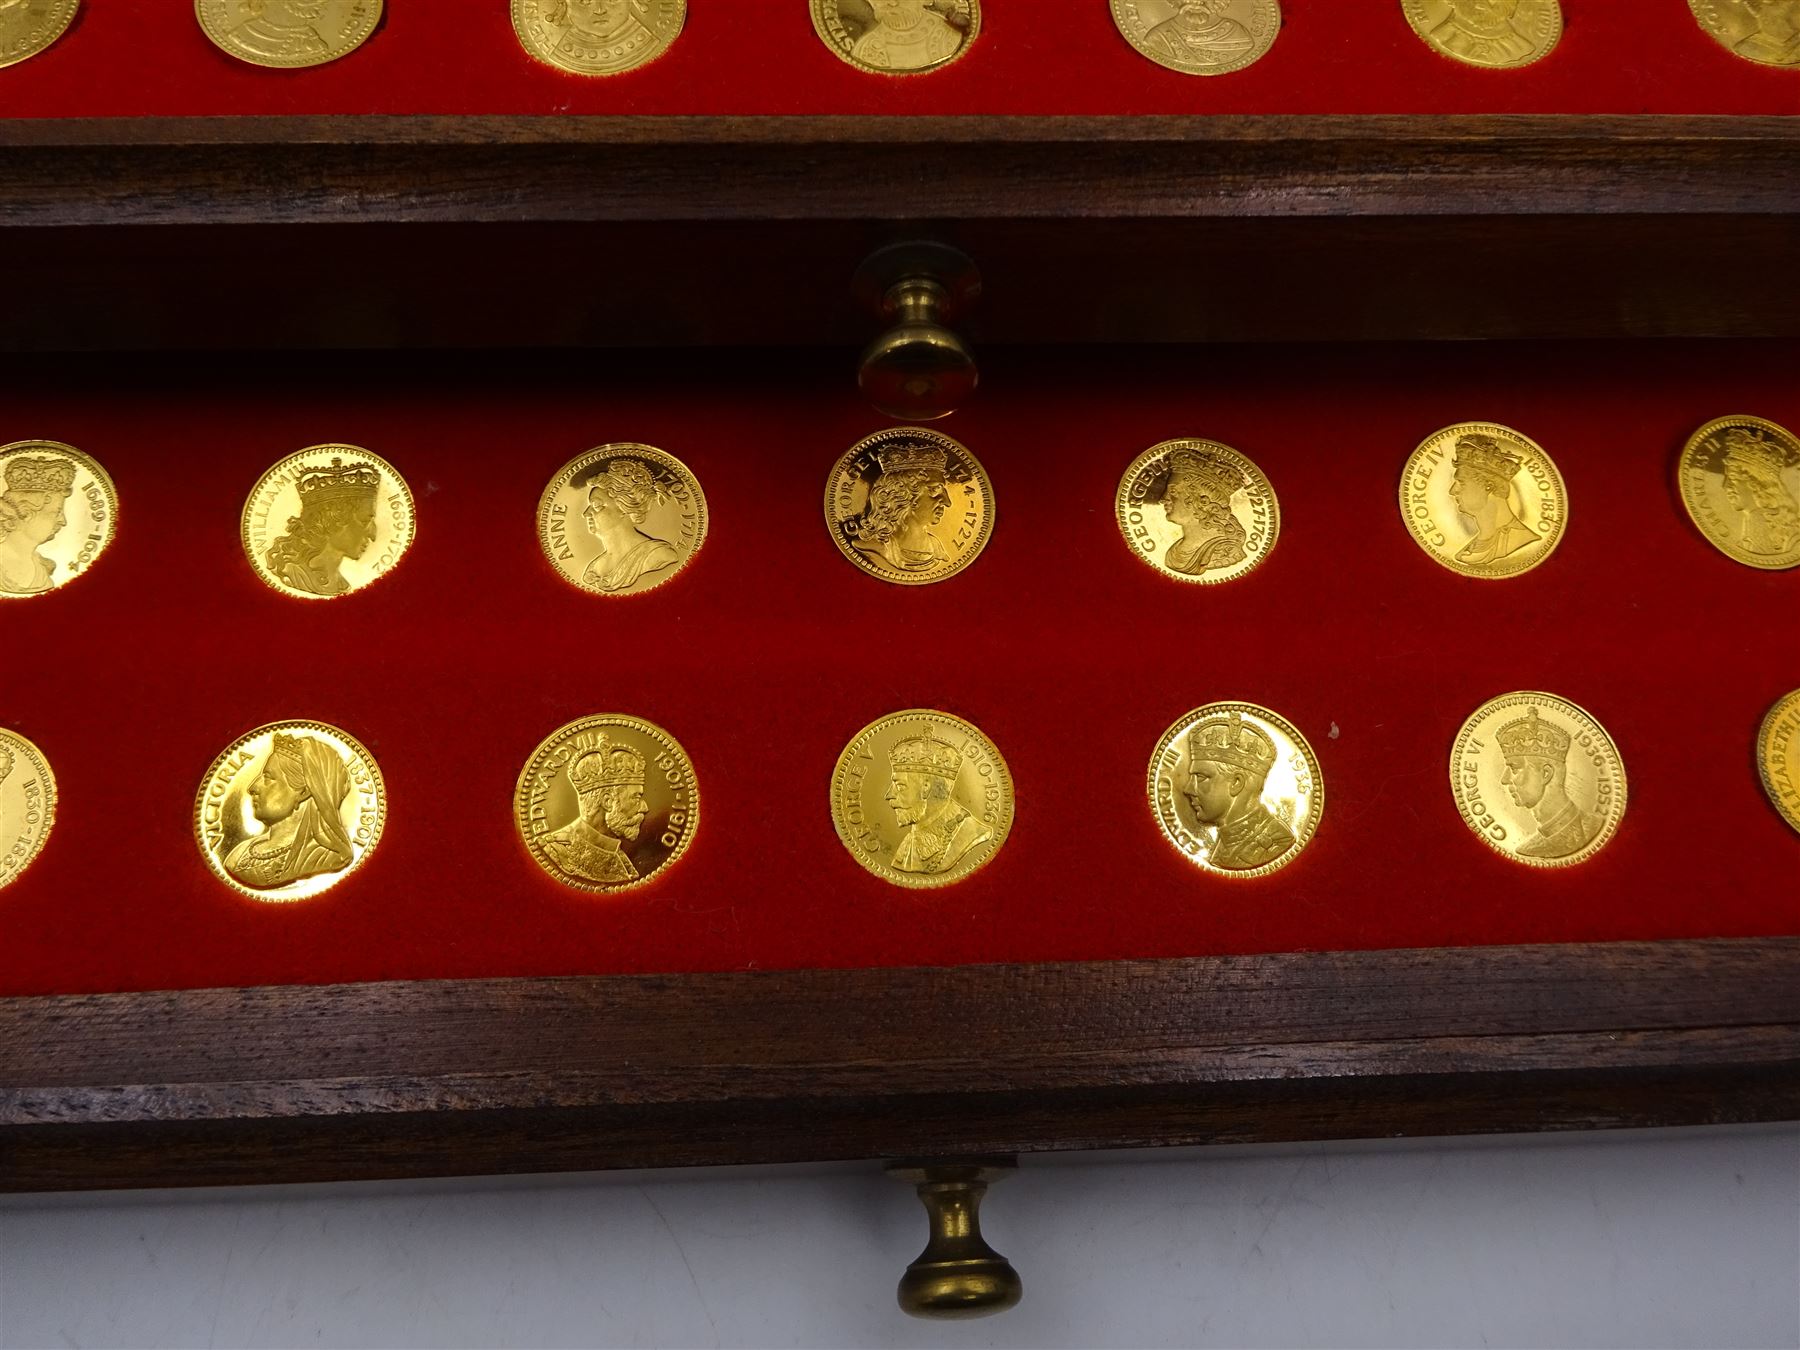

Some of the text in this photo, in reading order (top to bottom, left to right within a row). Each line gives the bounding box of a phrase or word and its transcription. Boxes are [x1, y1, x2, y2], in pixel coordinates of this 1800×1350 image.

[68, 481, 106, 572] 1689-1694
[252, 474, 296, 555] WILLIAM
[372, 493, 406, 574] 1689-1702
[550, 503, 574, 562] ANNE
[655, 469, 696, 550] 1702-1714
[840, 458, 870, 537] GEORGE
[950, 463, 977, 551] 1714-1727
[1129, 471, 1156, 553] GEORGE
[1244, 482, 1266, 552] 1727-1760
[1412, 444, 1446, 547] GEORGE IV
[1523, 457, 1555, 533] 1820-1830
[204, 750, 255, 851] VICTORIA
[344, 754, 377, 848] 1837-1901
[529, 732, 597, 836] EDWARD VII
[654, 751, 688, 848] 1901-1910
[847, 743, 881, 854] GEORGE V
[960, 738, 1001, 825] 1910-1936
[1288, 752, 1313, 795] 1936
[1463, 737, 1507, 842] GEORGE VI
[1573, 730, 1612, 817] 1936-1952
